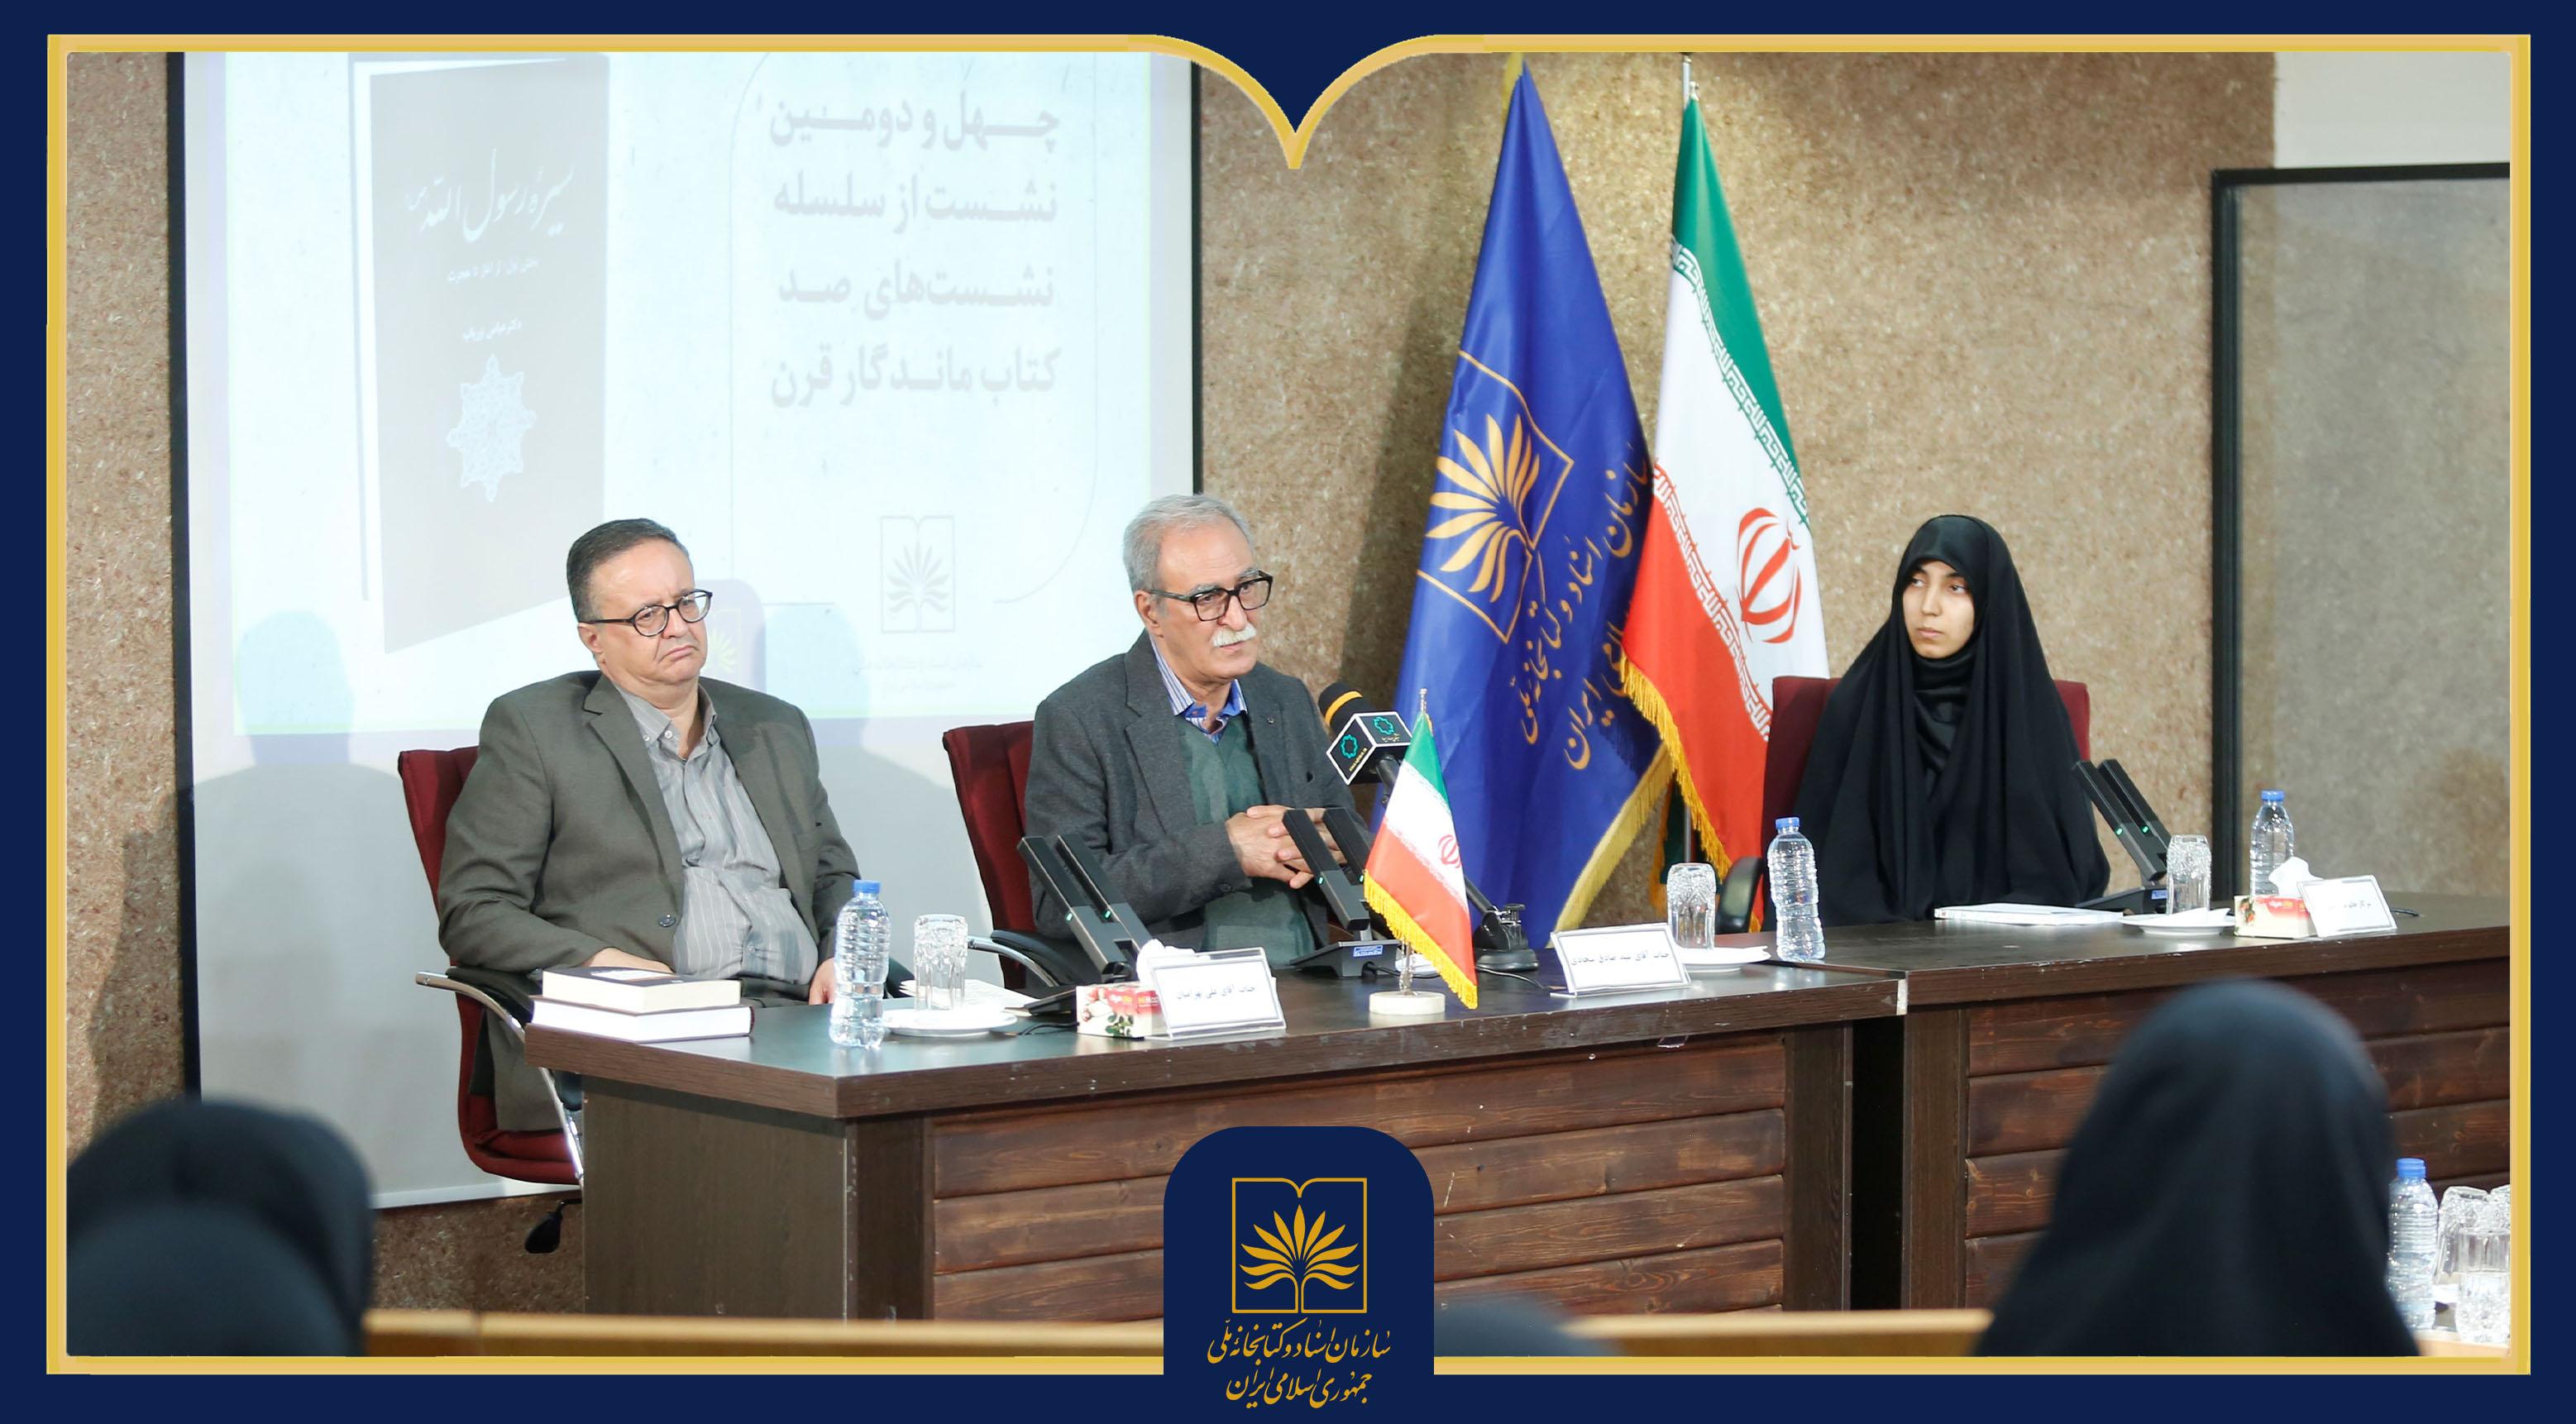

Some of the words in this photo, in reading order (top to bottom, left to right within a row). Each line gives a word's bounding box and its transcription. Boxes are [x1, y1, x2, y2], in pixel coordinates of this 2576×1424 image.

[769, 98, 915, 151] دومین
[920, 108, 938, 151] و
[943, 88, 1061, 154] چهل
[772, 168, 887, 219] سلسله
[892, 172, 920, 235] از
[924, 178, 1059, 223] نشست
[777, 268, 853, 303] صد
[769, 341, 835, 409] قرن
[839, 342, 973, 408] ماندگار
[979, 344, 1063, 408] کتاب
[1559, 598, 1574, 624] و
[1564, 676, 1616, 771] ایران
